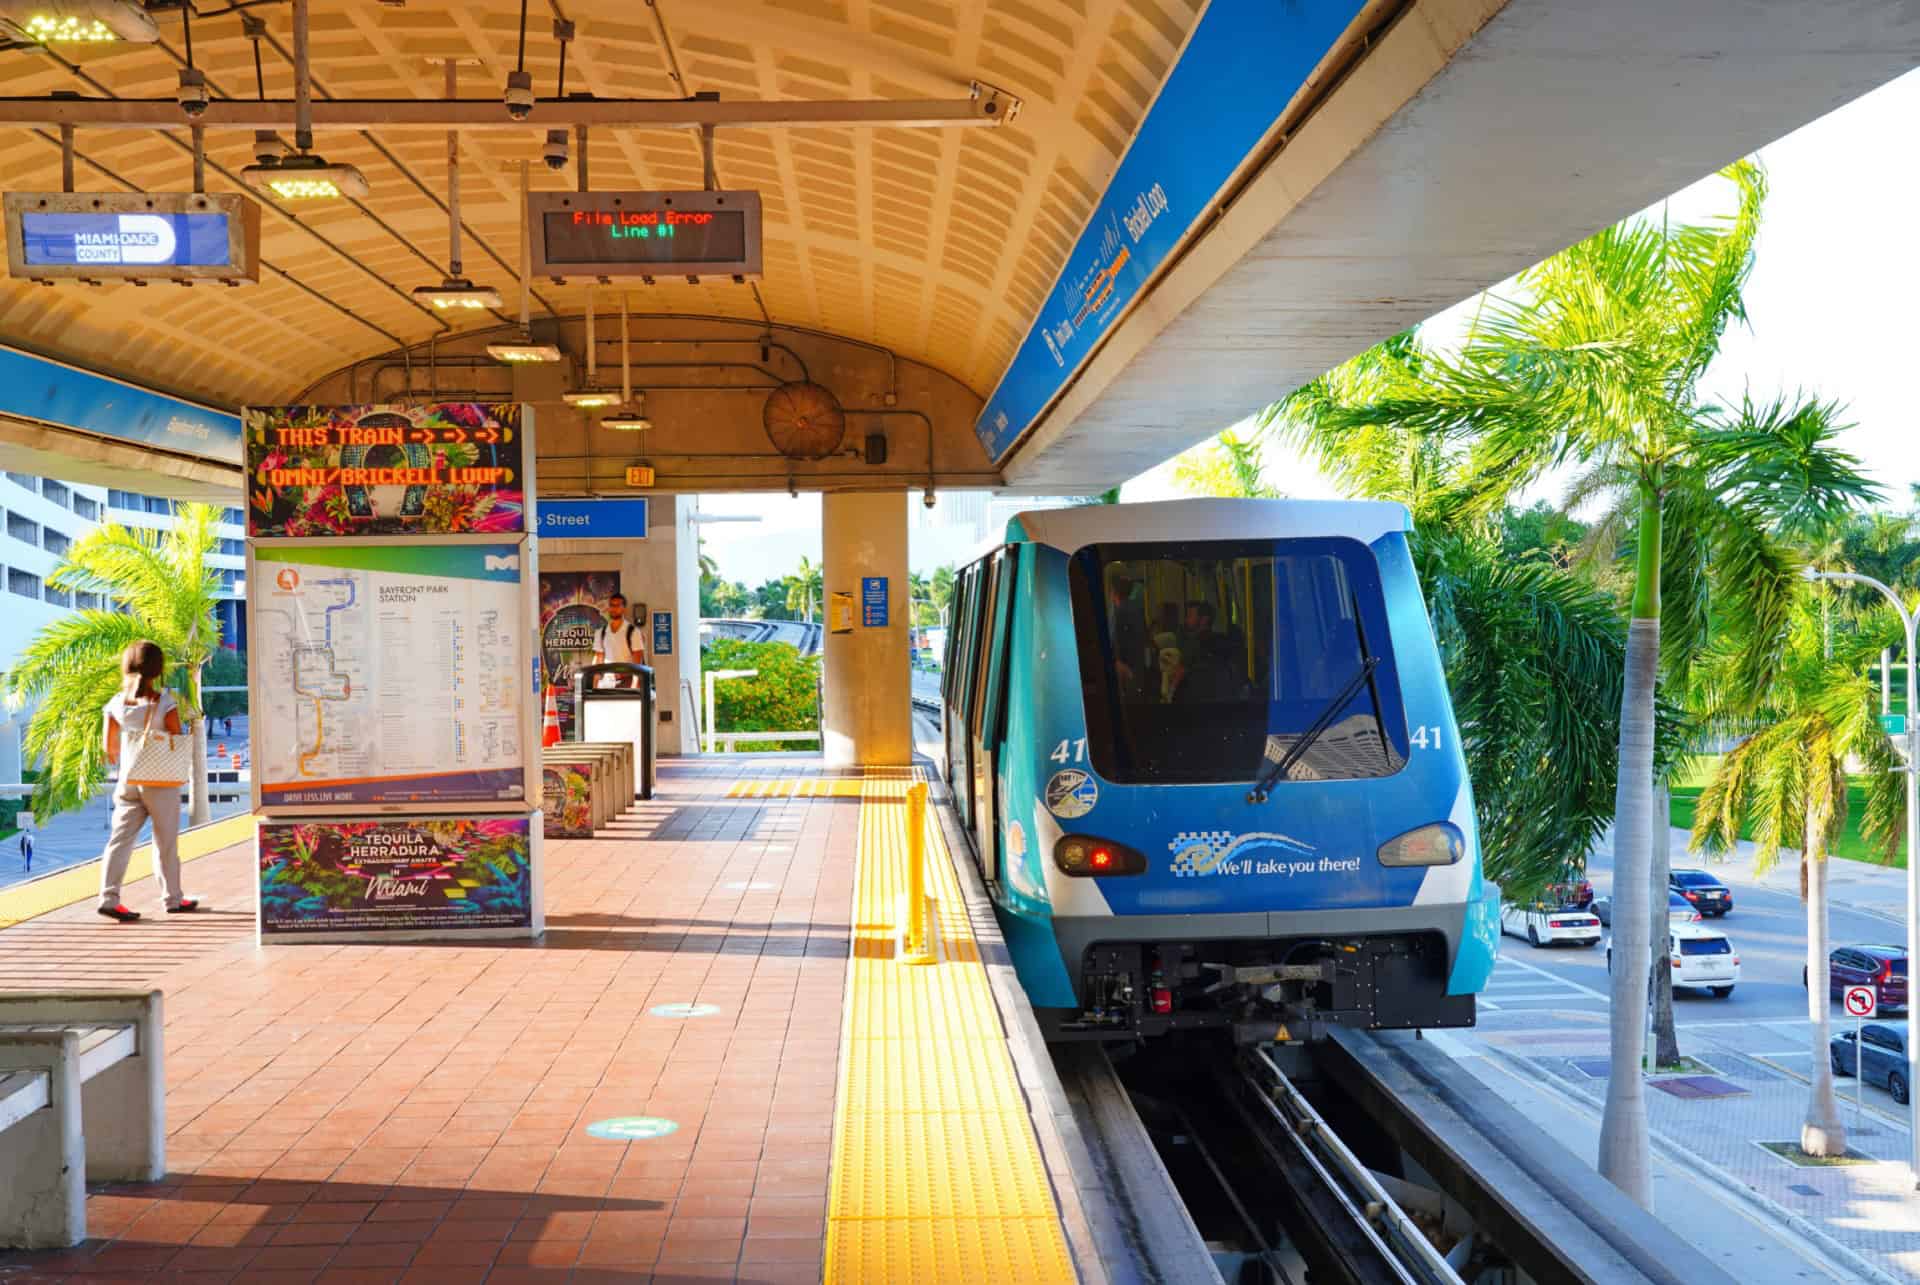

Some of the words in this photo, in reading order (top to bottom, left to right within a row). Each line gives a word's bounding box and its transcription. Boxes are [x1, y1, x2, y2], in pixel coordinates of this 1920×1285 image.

[573, 211, 613, 225] File
[620, 211, 658, 225] Load
[665, 211, 713, 225] Error
[611, 224, 649, 238] Line
[75, 232, 159, 246] MIAMI-DADE
[77, 248, 119, 261] COUNTY
[276, 427, 328, 445] THIS
[338, 427, 404, 445] TRAIN
[270, 467, 442, 485] OMNI/BRICKELL
[546, 513, 591, 526] Street
[379, 585, 424, 595] BAYFRONT
[426, 585, 449, 593] PARK
[379, 594, 416, 603] STATION
[557, 628, 594, 638] TEQUIL
[1409, 725, 1441, 750] 41
[1050, 737, 1086, 764] 41
[365, 832, 424, 845] TEQUILA
[351, 844, 440, 857] HERRADURA
[1216, 859, 1251, 876] We'll
[1256, 860, 1287, 874] take
[1289, 862, 1315, 877] you
[1318, 857, 1361, 872] there!
[364, 875, 429, 900] Miami
